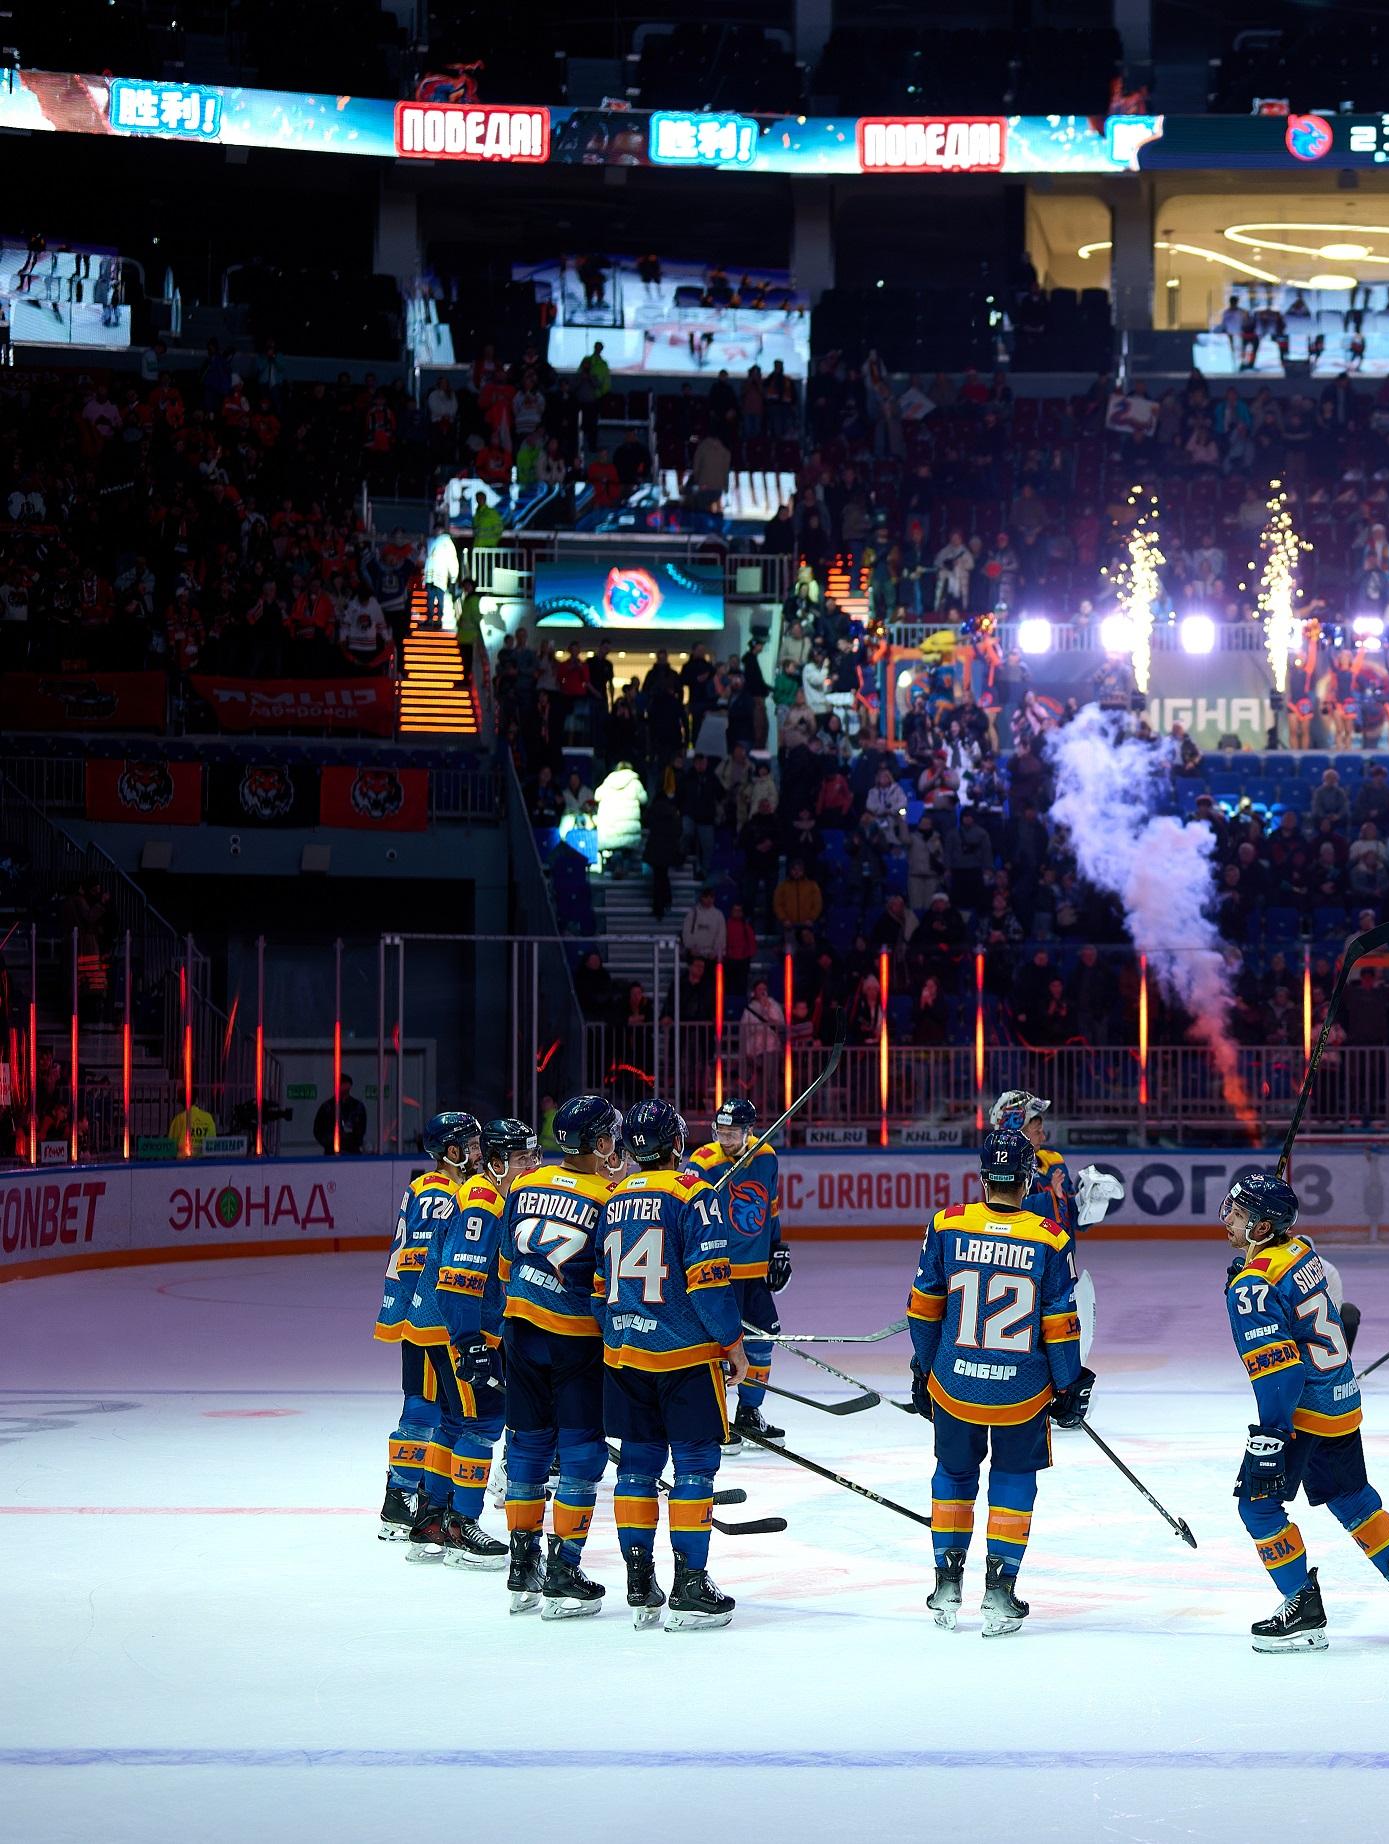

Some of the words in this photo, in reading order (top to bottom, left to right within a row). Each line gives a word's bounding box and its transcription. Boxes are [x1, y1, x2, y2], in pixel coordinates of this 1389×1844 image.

[403, 109, 541, 157] ПОБЕДА!
[865, 122, 1000, 169] ПОБЕДА!
[633, 1135, 645, 1146] 14
[810, 1131, 863, 1144] KHL.RU
[905, 1131, 958, 1144] KHL.RU
[995, 1151, 1008, 1163] 12
[0, 1181, 106, 1254] ONBET
[517, 1192, 599, 1230] RENDULIC
[607, 1198, 662, 1225] SUTTER
[694, 1198, 724, 1226] 14
[465, 1217, 483, 1242] 9
[514, 1216, 590, 1285] 17
[604, 1226, 669, 1304] 14
[955, 1237, 1035, 1271] LABANC
[948, 1269, 1036, 1353] 12
[1235, 1284, 1270, 1315] 37
[1245, 1323, 1280, 1341] СИБУР
[953, 1358, 1017, 1381] СИБУР
[1247, 1345, 1298, 1374] 上海龙队
